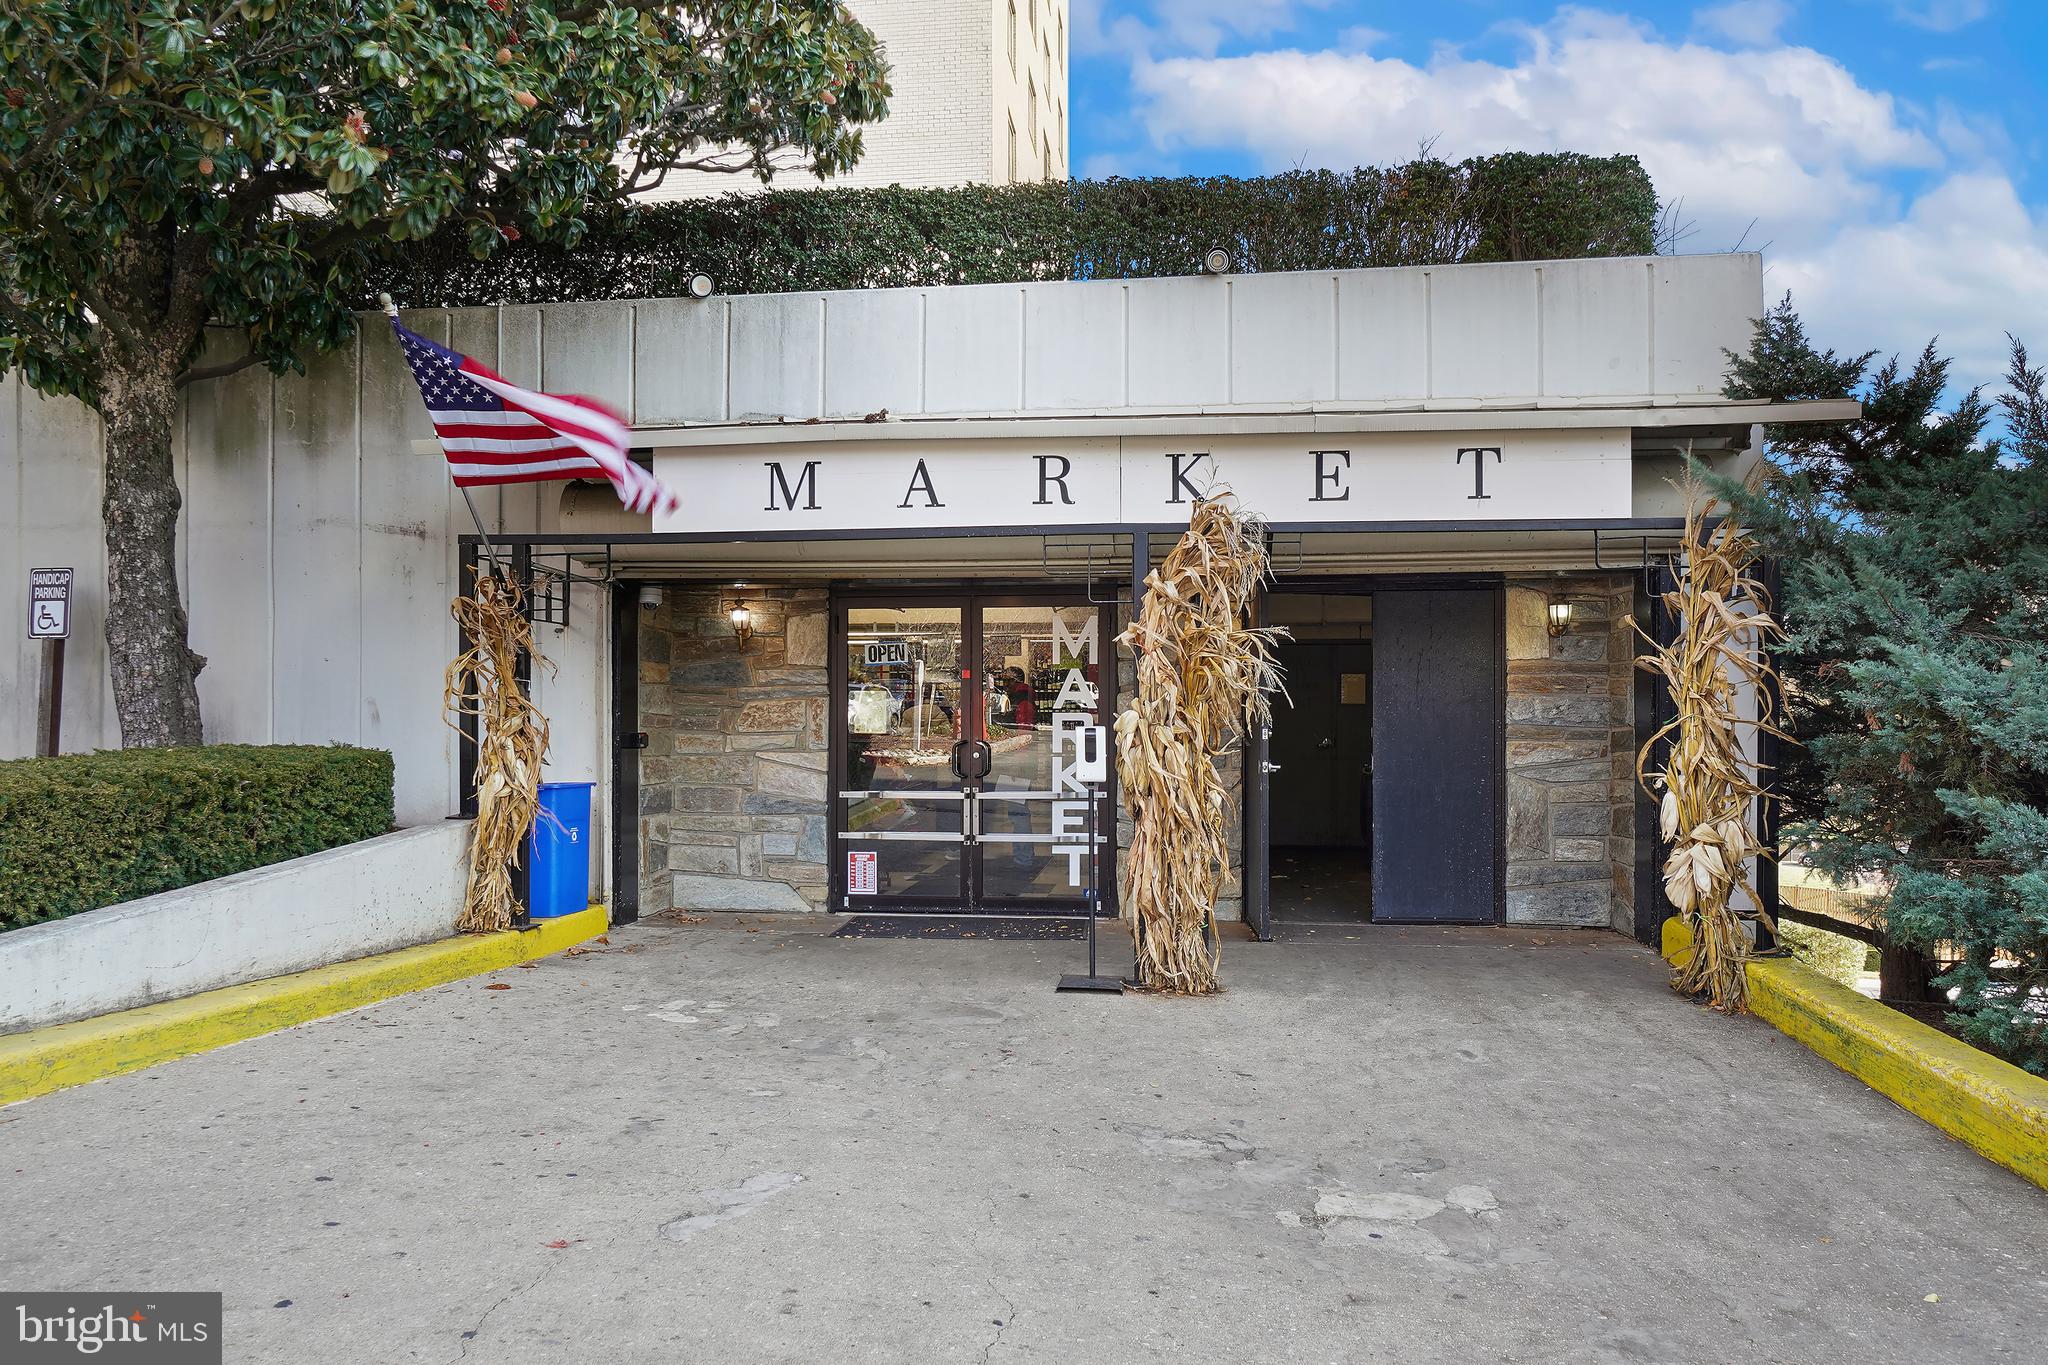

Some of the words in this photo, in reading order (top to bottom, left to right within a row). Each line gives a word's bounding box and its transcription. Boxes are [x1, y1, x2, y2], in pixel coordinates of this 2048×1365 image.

[763, 447, 1503, 512] MARKET
[32, 572, 70, 586] HANDICAP
[34, 586, 67, 599] PARKING
[868, 644, 905, 662] OPEN
